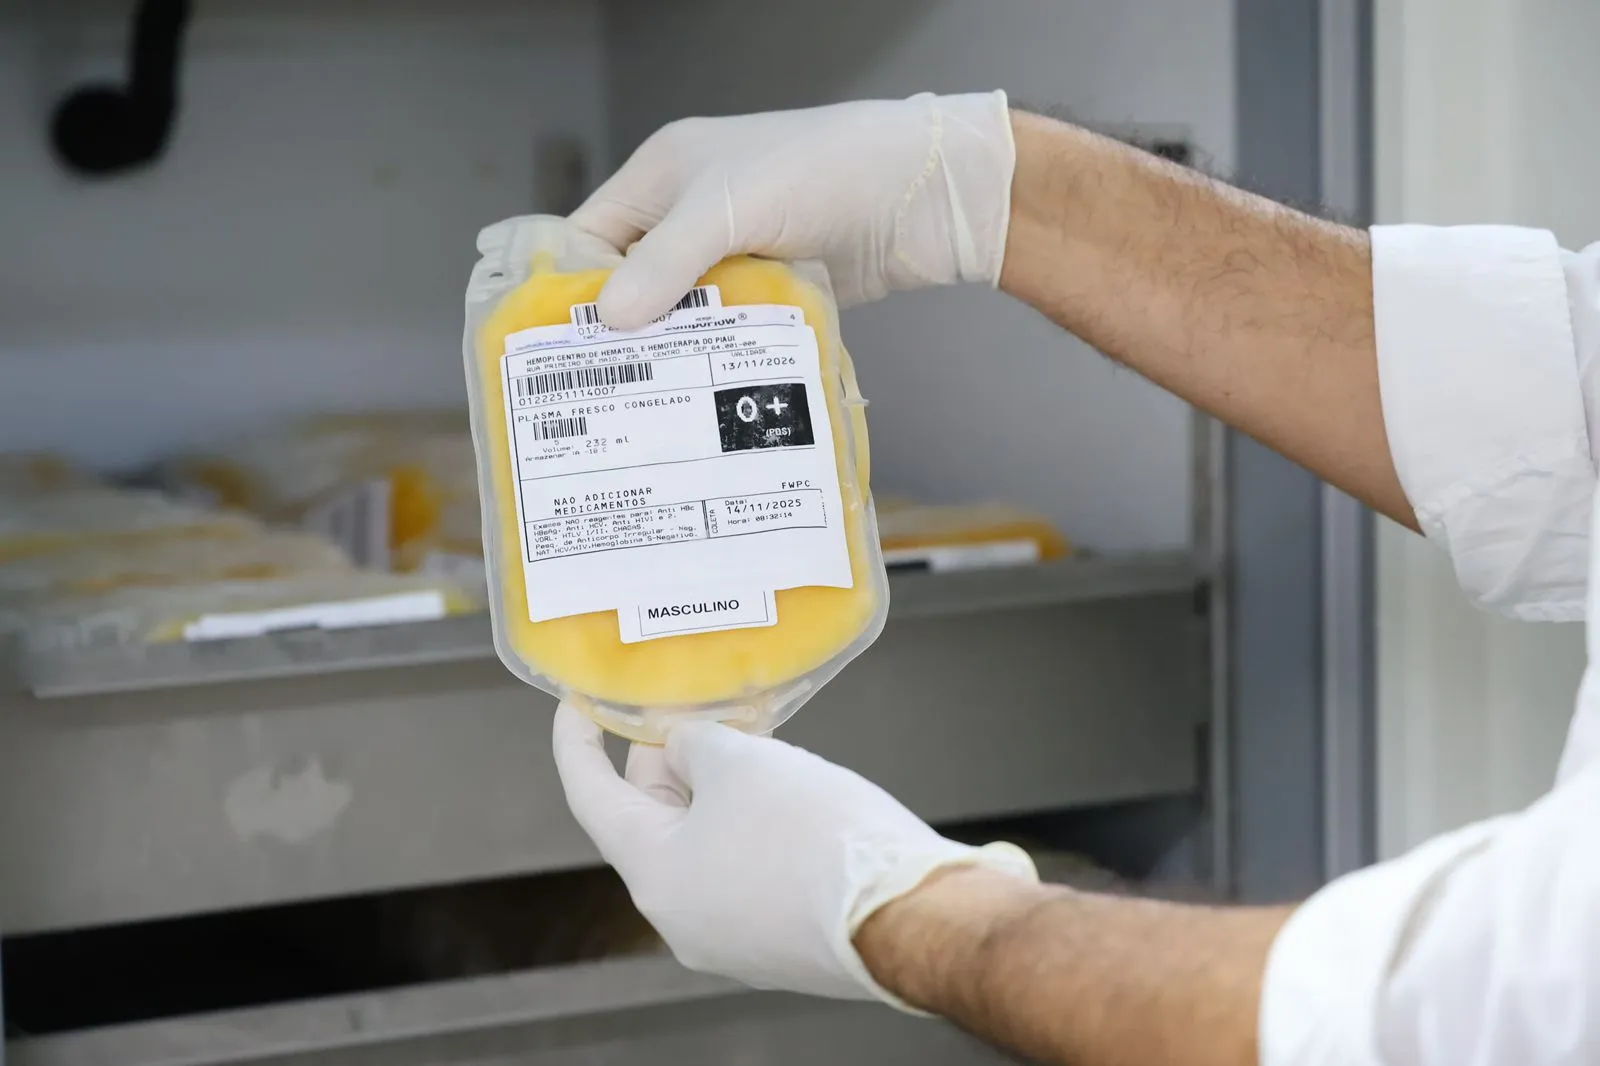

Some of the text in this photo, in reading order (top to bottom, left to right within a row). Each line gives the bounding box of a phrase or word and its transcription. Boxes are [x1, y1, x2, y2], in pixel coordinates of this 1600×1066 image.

[526, 356, 555, 366] HEMOPI
[556, 352, 587, 361] CENTRO
[647, 339, 700, 351] HEMOTERAPIA
[702, 337, 713, 345] DO
[715, 335, 735, 343] PIAUI
[544, 360, 581, 369] PRIMEIRO
[652, 349, 681, 358] CENTRO
[730, 348, 767, 358] VALIDADE
[721, 356, 796, 371] 13/11/2026
[518, 386, 616, 406] 0122251114007
[518, 395, 692, 423] PLASMA FRESCO CONGELADO
[585, 438, 608, 448] 232
[781, 479, 811, 490] FWPC
[553, 487, 653, 507] NAO ADICIONAR
[725, 499, 748, 507] Data:
[554, 497, 647, 516] MEDICAMENTOS
[726, 499, 802, 515] 14/11/2025
[708, 509, 719, 534] COLETA
[727, 518, 751, 526] Hora:
[577, 534, 619, 544] Anticorpo
[624, 528, 664, 538] Irregular
[648, 599, 740, 619] MASCULINO
